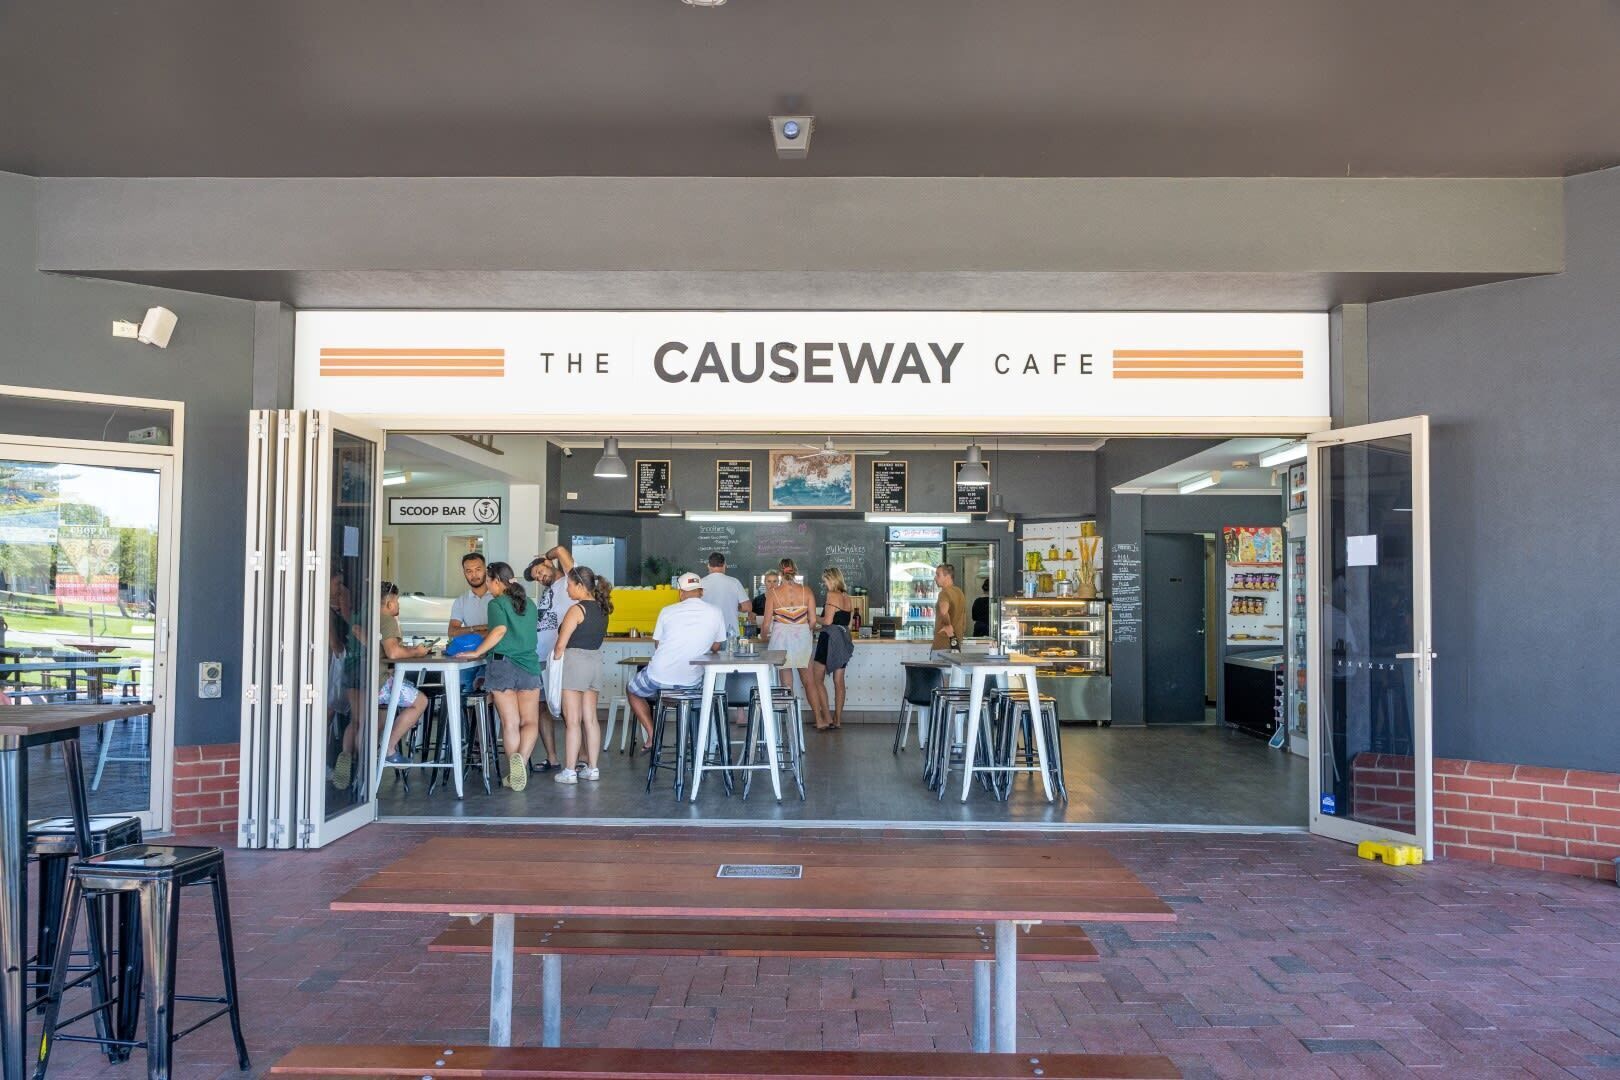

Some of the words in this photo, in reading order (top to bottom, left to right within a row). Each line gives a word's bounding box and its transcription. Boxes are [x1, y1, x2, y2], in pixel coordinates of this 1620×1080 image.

[540, 352, 609, 374] THE
[653, 341, 965, 384] CAUSEWAY
[994, 353, 1093, 375] CAFE
[399, 506, 439, 516] SCOOP
[442, 506, 466, 516] BAR
